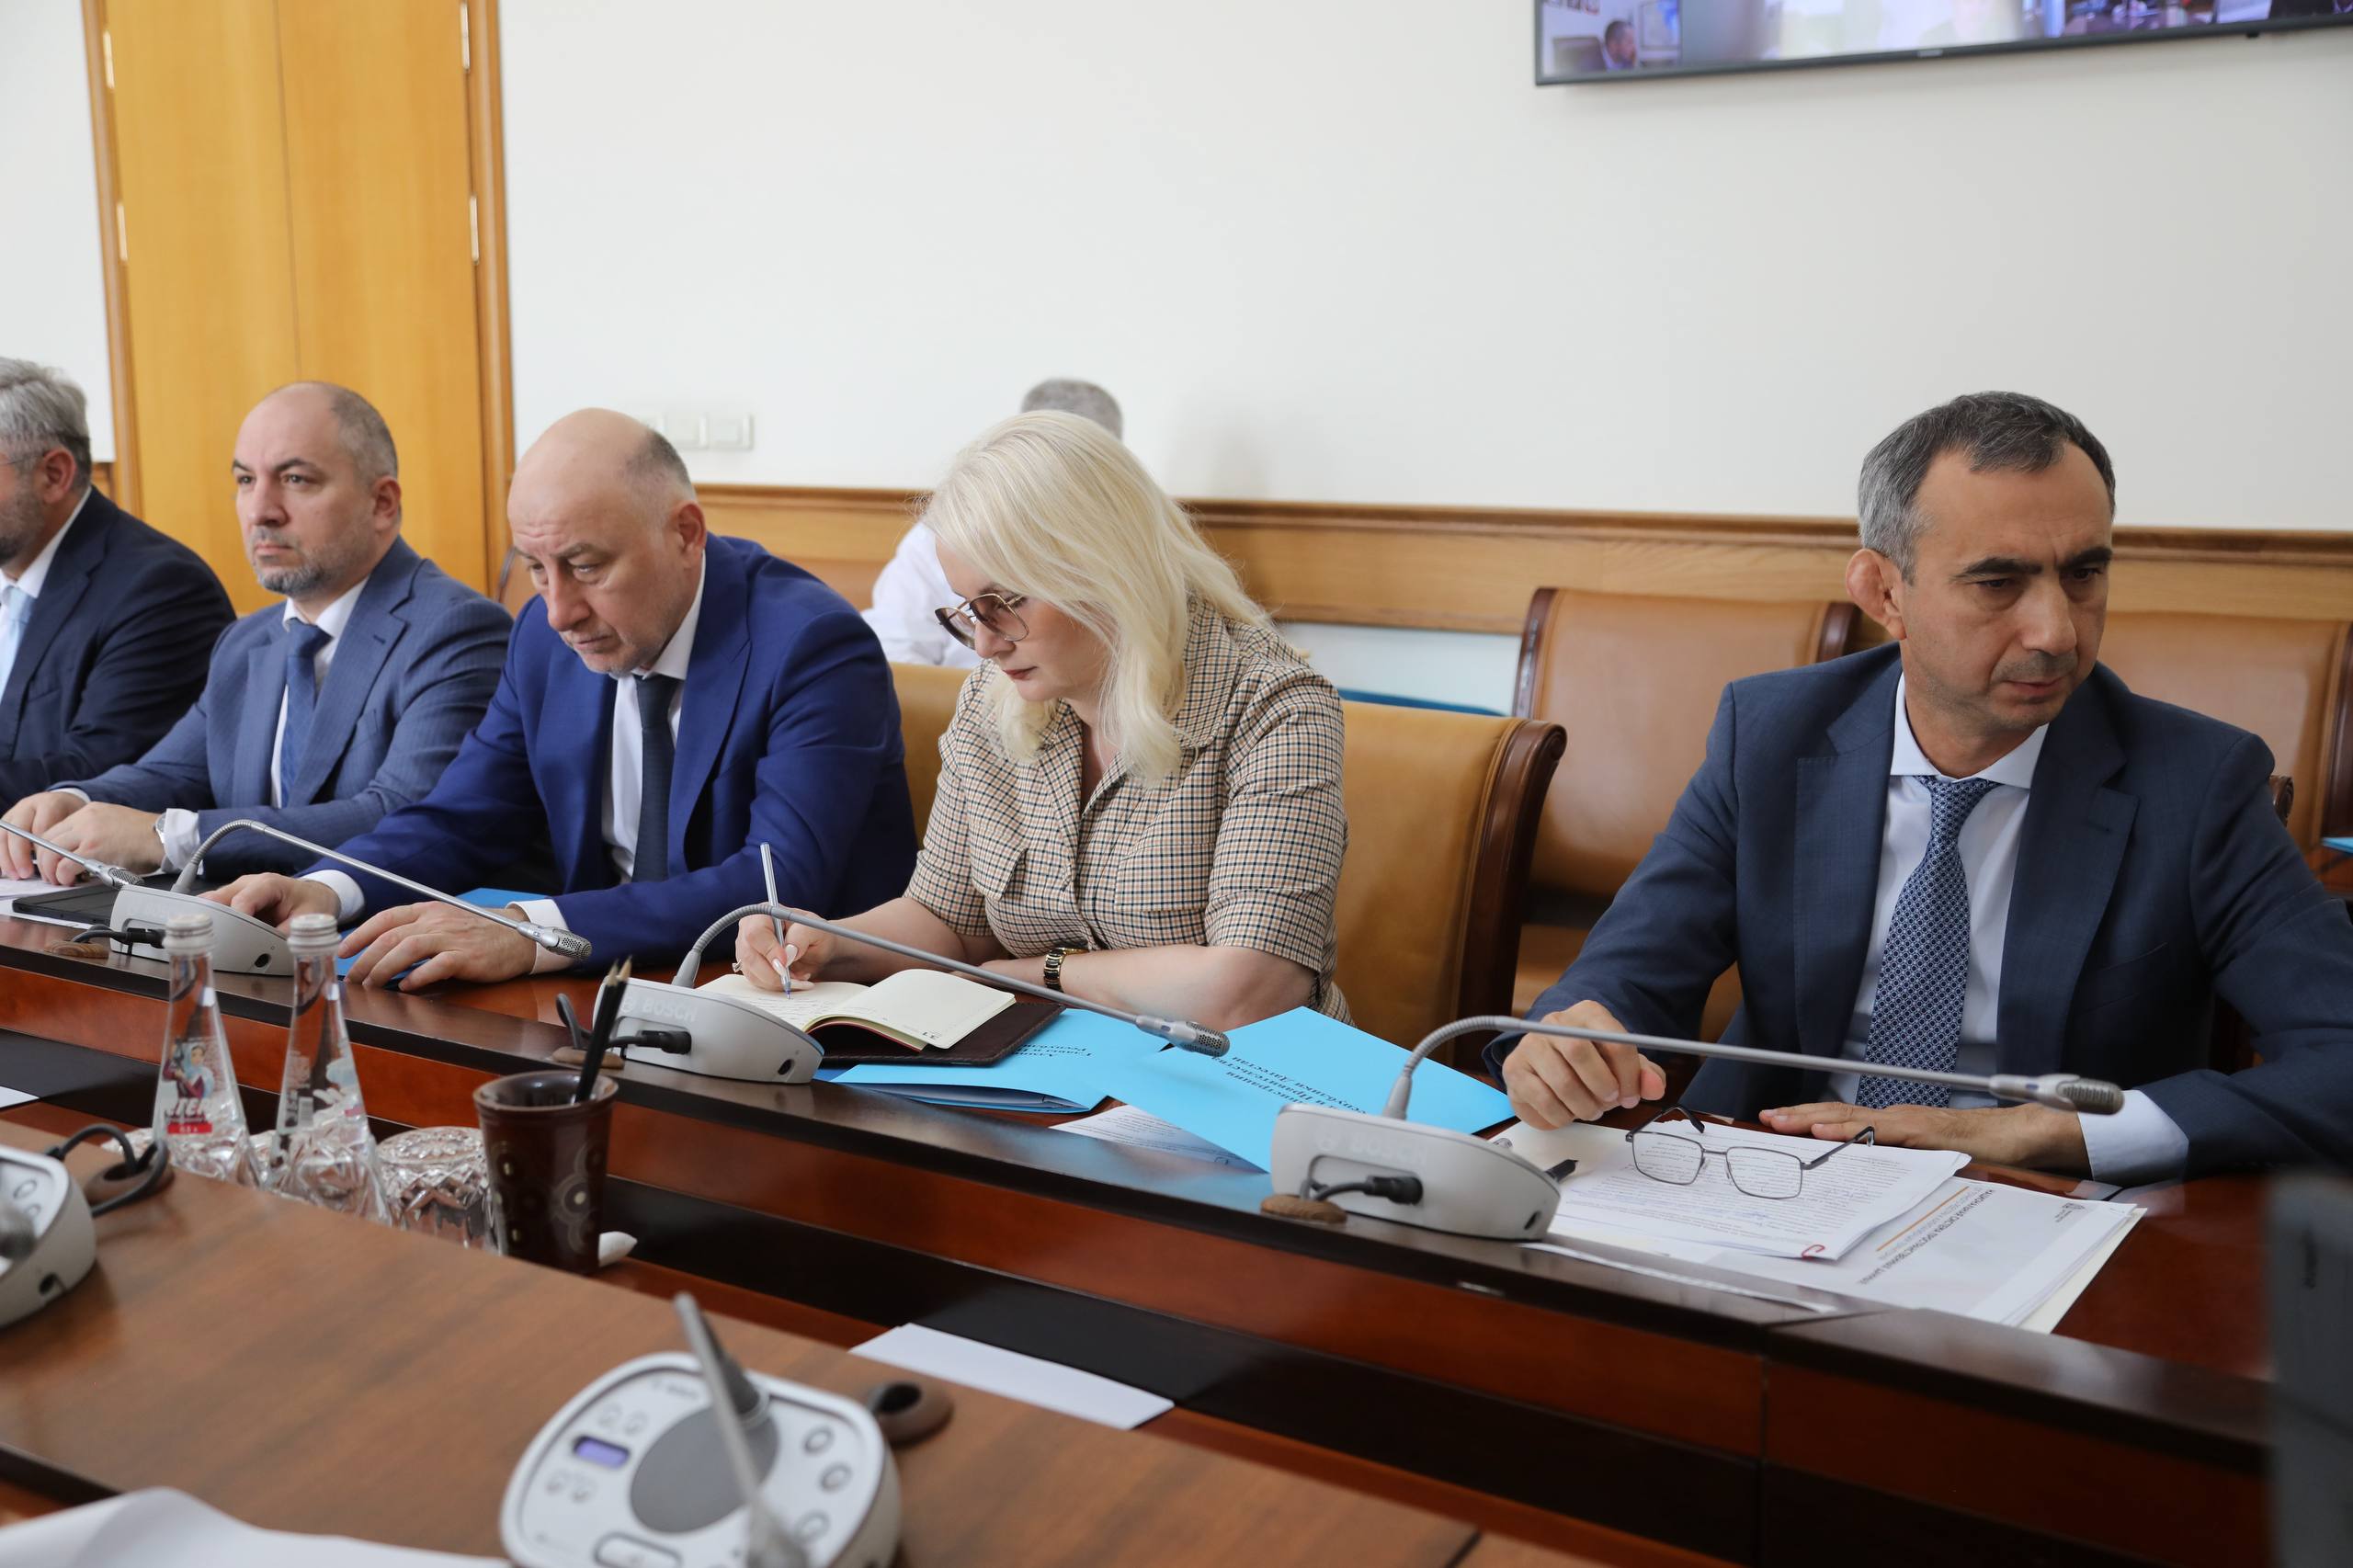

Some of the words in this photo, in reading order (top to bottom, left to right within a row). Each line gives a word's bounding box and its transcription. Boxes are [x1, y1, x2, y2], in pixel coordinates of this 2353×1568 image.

[642, 996, 698, 1022] BOSCH
[1232, 1056, 1294, 1083] Дагестан
[1295, 1082, 1367, 1114] еспублики
